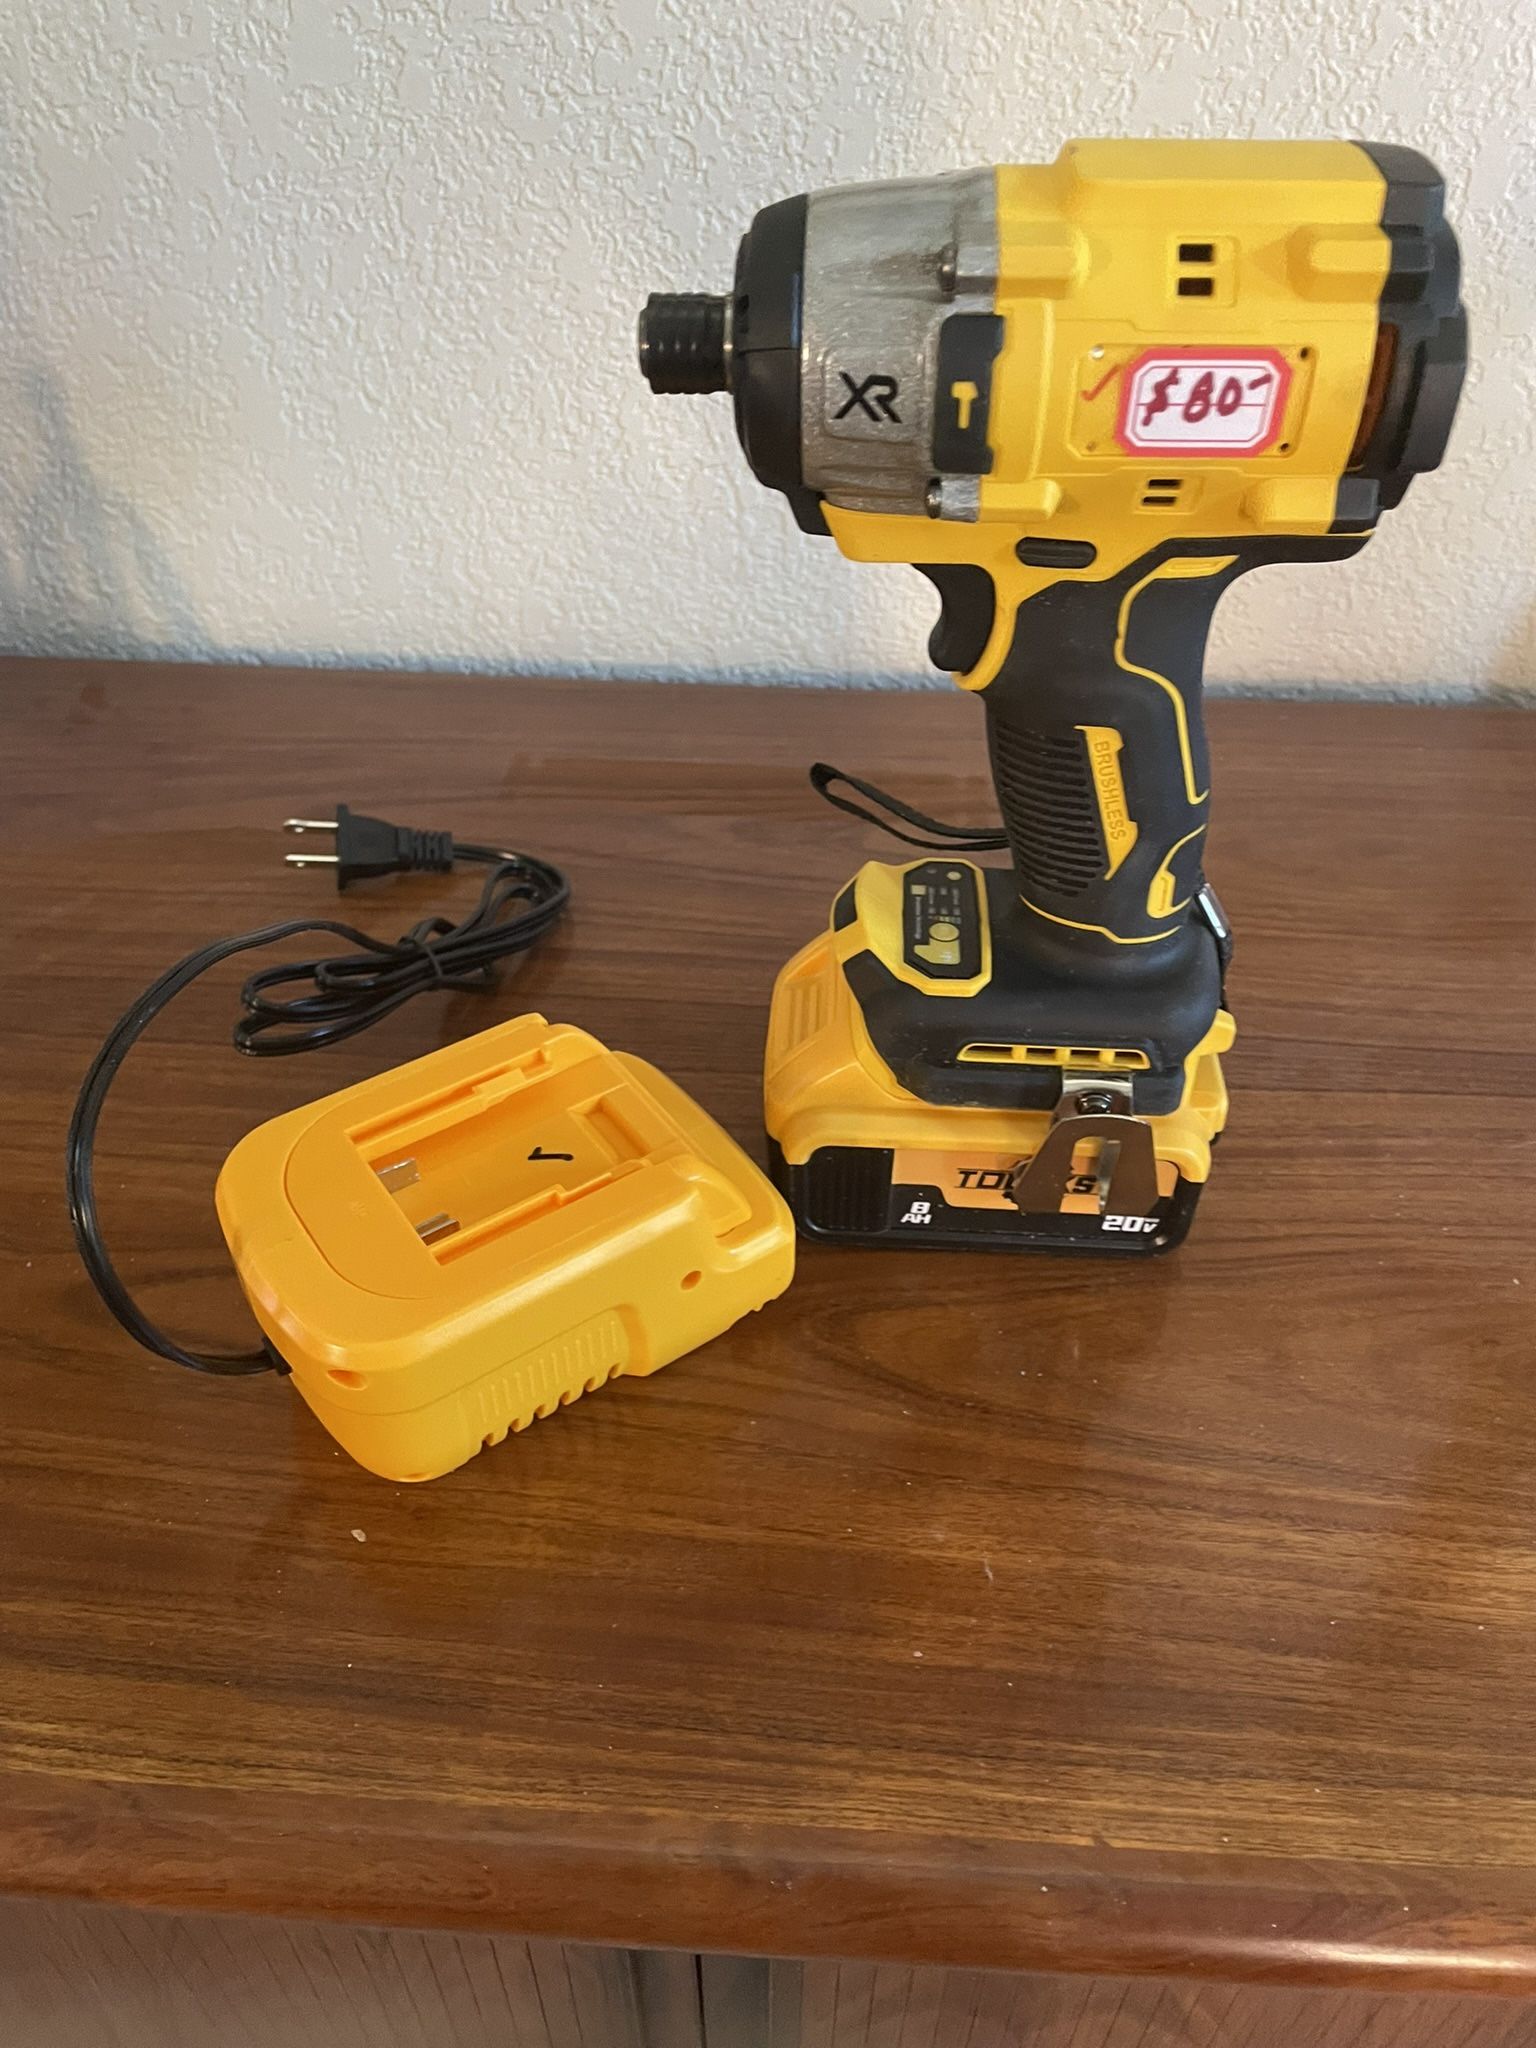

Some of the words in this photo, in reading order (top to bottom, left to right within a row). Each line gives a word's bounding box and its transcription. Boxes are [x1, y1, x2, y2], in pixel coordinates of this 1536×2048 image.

[831, 371, 903, 424] XR
[1093, 740, 1127, 840] BRUSHLESS
[900, 1212, 932, 1225] AH
[910, 1201, 931, 1214] 8
